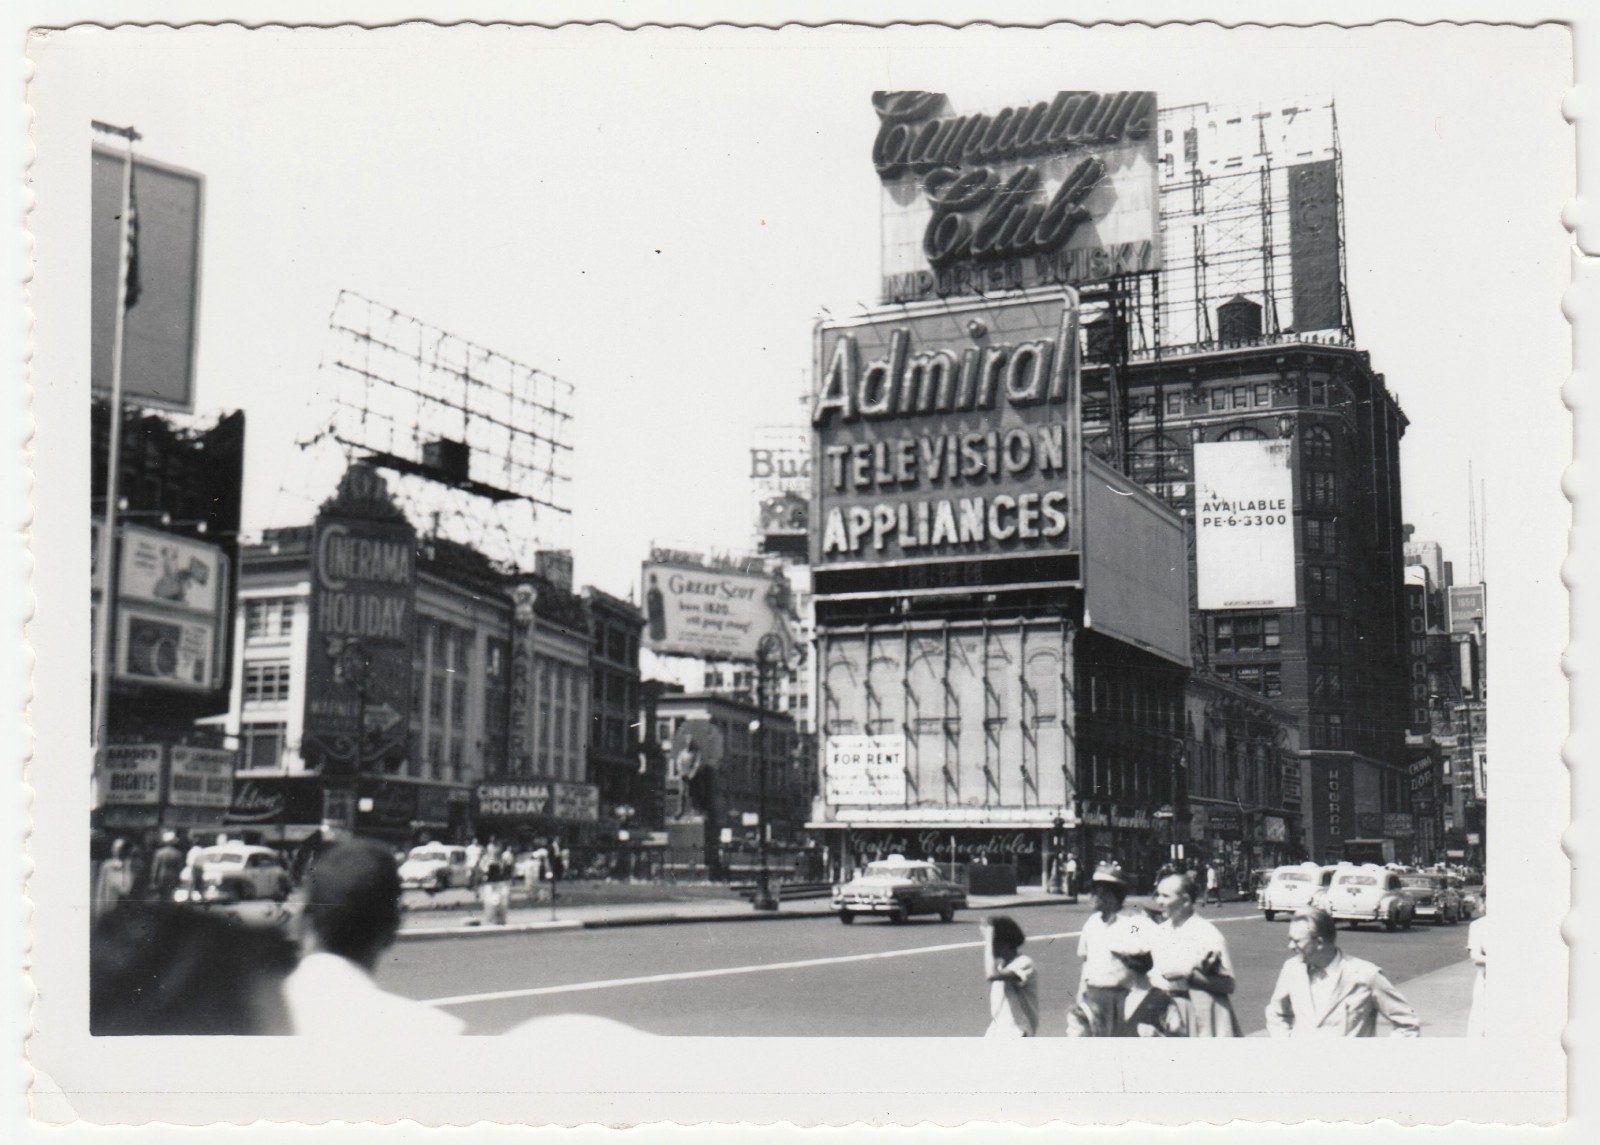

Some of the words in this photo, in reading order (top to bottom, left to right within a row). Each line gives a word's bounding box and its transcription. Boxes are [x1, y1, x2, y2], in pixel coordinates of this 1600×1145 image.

[924, 156, 1099, 269] Club
[1035, 240, 1151, 285] WHISKY
[812, 308, 1077, 427] Admiral
[827, 424, 1066, 491] TELEVISION
[823, 490, 1069, 555] APPLIANCES
[1203, 499, 1287, 513] AVAILABLE
[317, 523, 411, 591] CINERAMA
[318, 591, 406, 638] HOLIDAY
[1409, 593, 1429, 724] HOWARD
[476, 784, 550, 799] CINERAMA
[834, 753, 861, 765] FOR
[867, 753, 900, 765] RENT
[479, 800, 546, 815] HOLIDAY
[1328, 769, 1341, 836] HOWARD
